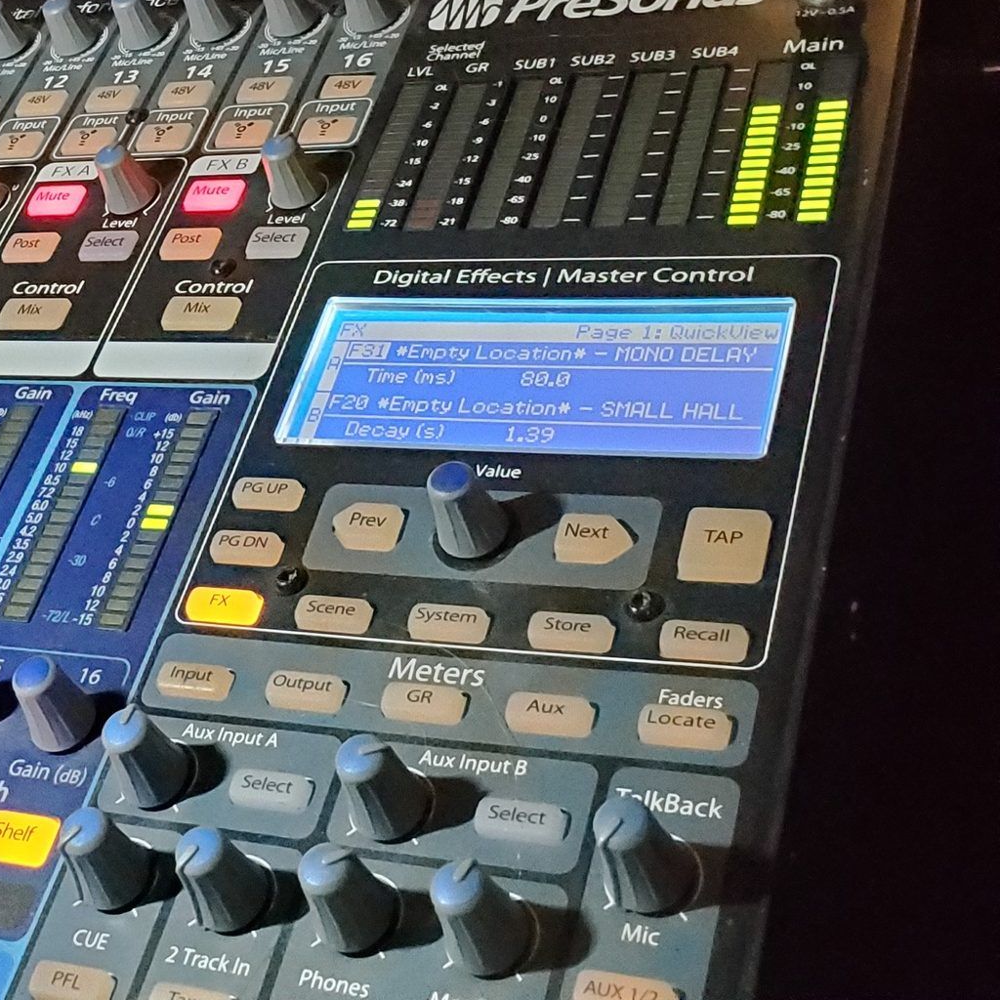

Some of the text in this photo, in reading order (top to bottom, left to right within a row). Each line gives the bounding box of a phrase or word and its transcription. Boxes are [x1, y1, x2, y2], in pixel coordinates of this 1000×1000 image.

[430, 40, 486, 53] Selected
[691, 45, 739, 59] SUB4
[783, 37, 844, 54] Main
[343, 52, 373, 68] 16
[426, 49, 482, 62] Channel
[570, 53, 617, 67] SUB2
[629, 49, 676, 63] SUB3
[186, 64, 214, 80] 14
[263, 58, 292, 74] 15
[407, 65, 434, 78] LVL
[465, 62, 489, 74] GR
[513, 57, 556, 71] SUB1
[333, 80, 361, 91] 48V
[314, 102, 357, 114] Input
[514, 175, 532, 184] -40
[36, 190, 70, 202] Mute
[193, 184, 230, 196] Mute
[102, 217, 138, 230] Level
[267, 213, 306, 226] Level
[380, 219, 398, 228] -72
[438, 217, 456, 226] -21
[13, 238, 40, 249] Post
[85, 236, 125, 248] Select
[171, 232, 202, 244] Post
[252, 231, 297, 244] Select
[373, 266, 755, 287] Digital Effects Master Control
[12, 280, 85, 296] Control
[174, 279, 254, 295] Control
[17, 303, 42, 315] Mix
[183, 302, 211, 314] Mix
[340, 323, 367, 337] FX
[576, 325, 632, 341] Page
[670, 324, 780, 340] QuickView
[351, 343, 384, 358] F31
[614, 346, 674, 362] MONO
[680, 347, 757, 363] DELAY
[367, 368, 571, 388] Time (ms) 80.0
[100, 388, 231, 406] Freq Gain
[328, 394, 370, 410] F20
[601, 401, 673, 419] SMALL
[682, 402, 743, 420] HALL
[345, 420, 555, 444] Decay (s) 1.39
[476, 464, 522, 479] Value
[242, 482, 289, 495] PG UP
[349, 512, 387, 528] Prev
[564, 523, 610, 540] Next
[703, 529, 744, 545] TAP
[219, 535, 269, 548] PG DN
[209, 594, 231, 606] FX
[306, 600, 356, 616] Scene
[415, 607, 478, 626] System
[544, 617, 592, 633] Store
[674, 626, 730, 643] Recall
[79, 667, 103, 685] 16
[170, 665, 213, 684] Input
[388, 656, 486, 687] Meters
[272, 674, 333, 694] Output
[406, 689, 434, 704] GR
[658, 689, 724, 709] Faders
[526, 699, 566, 716] Aux
[647, 711, 717, 730] Locate
[182, 722, 279, 748] Aux Input A
[418, 749, 528, 776] Aux Input B
[8, 759, 50, 781] Gain
[54, 765, 88, 788] (dB)
[241, 774, 294, 795] Select
[487, 804, 547, 826] Select
[72, 928, 111, 951] CUE
[620, 922, 661, 946] Mic
[165, 946, 251, 977] 2 Track In
[51, 970, 81, 992] PFL
[299, 968, 371, 999] Phones
[583, 979, 624, 998] AUX
